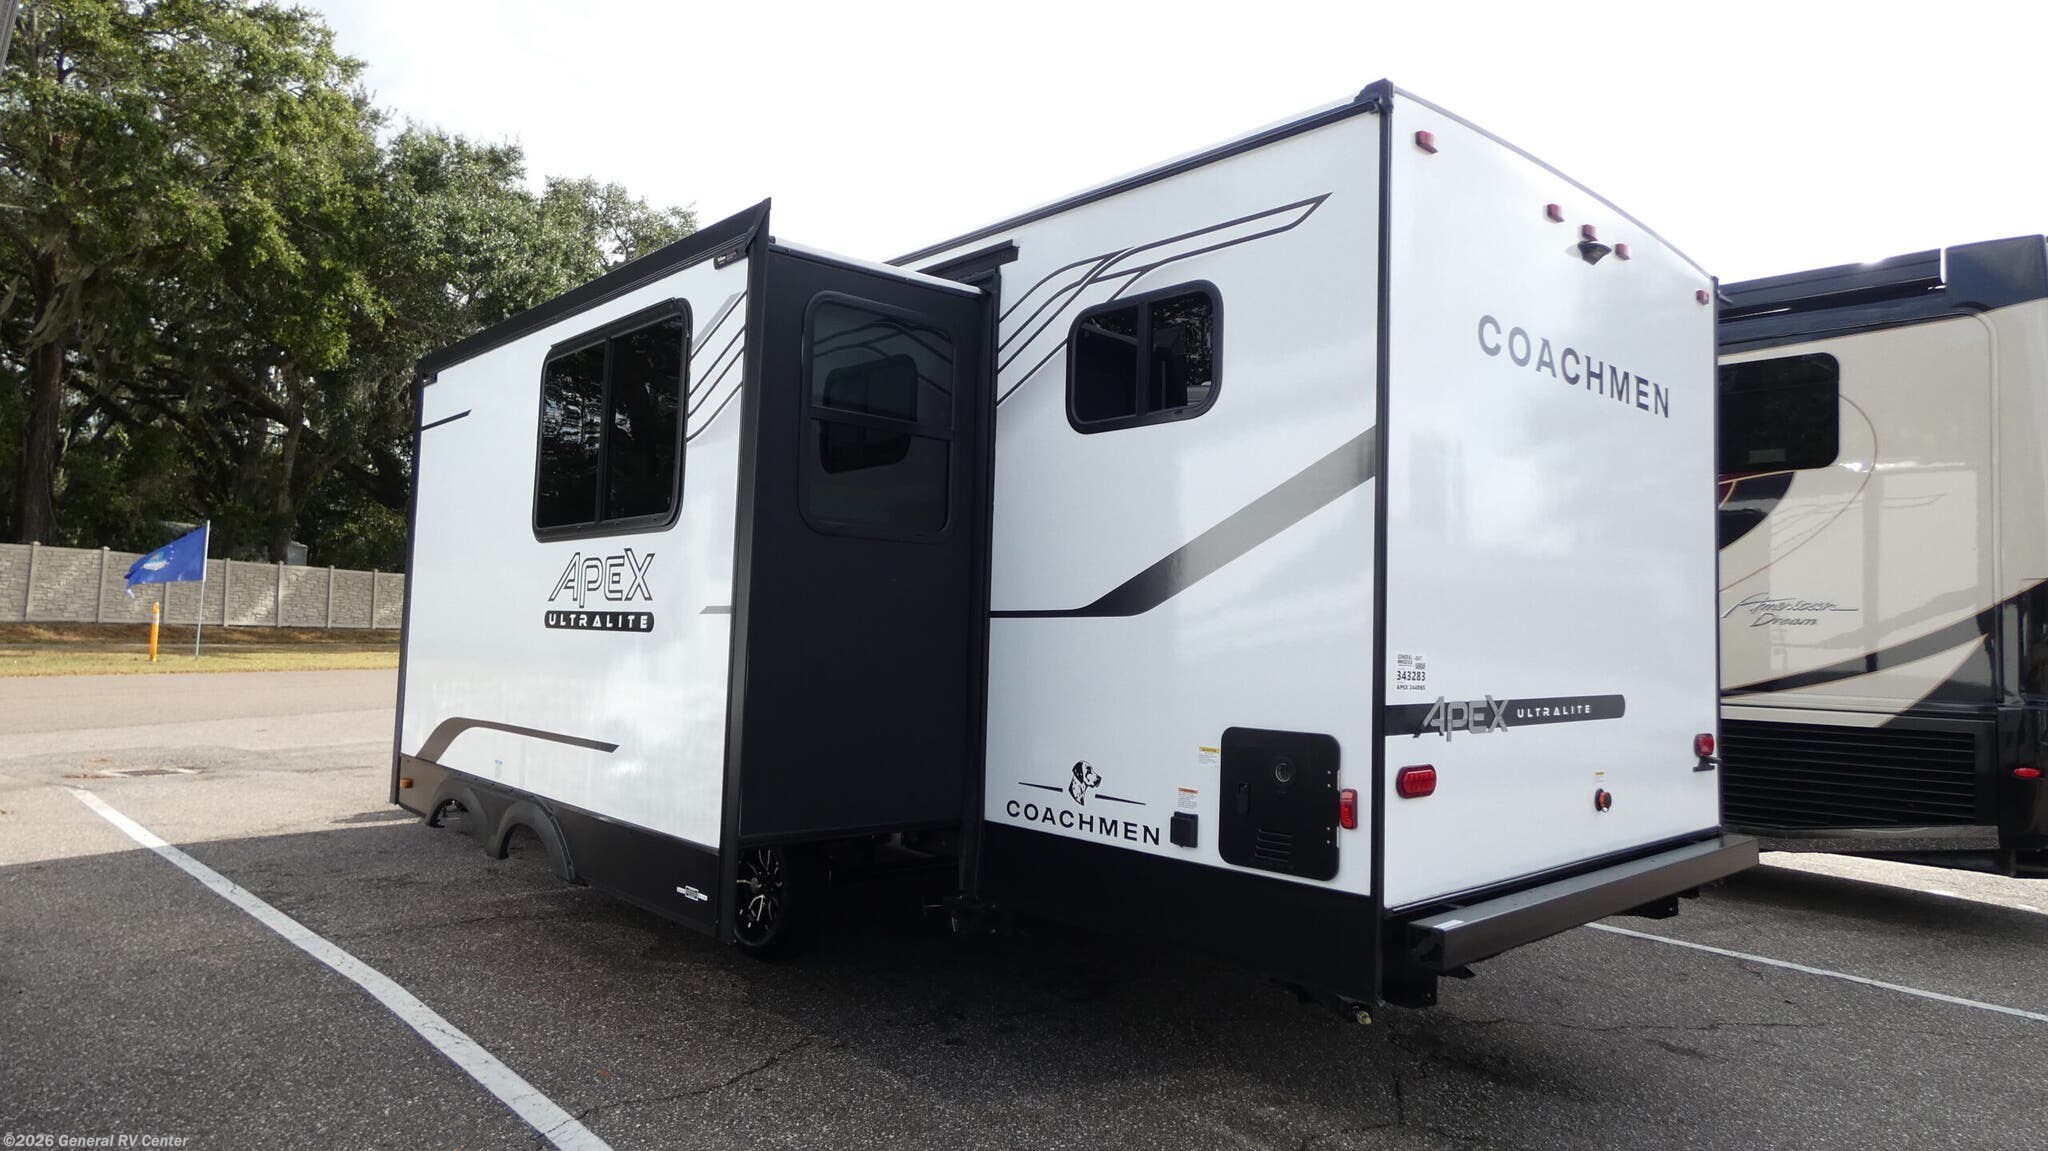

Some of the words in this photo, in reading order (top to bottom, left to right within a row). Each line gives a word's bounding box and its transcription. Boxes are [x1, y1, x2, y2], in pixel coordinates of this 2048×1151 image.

[1478, 314, 1669, 418] COACHMEN
[547, 547, 655, 608] APEX
[548, 613, 649, 629] ULTRALITE
[1720, 592, 1859, 618] American
[1749, 612, 1818, 627] Dream
[1396, 670, 1426, 682] 343283
[1412, 694, 1510, 742] APEX
[1516, 704, 1592, 718] ULTRALITE
[1006, 800, 1160, 846] COACHMEN
